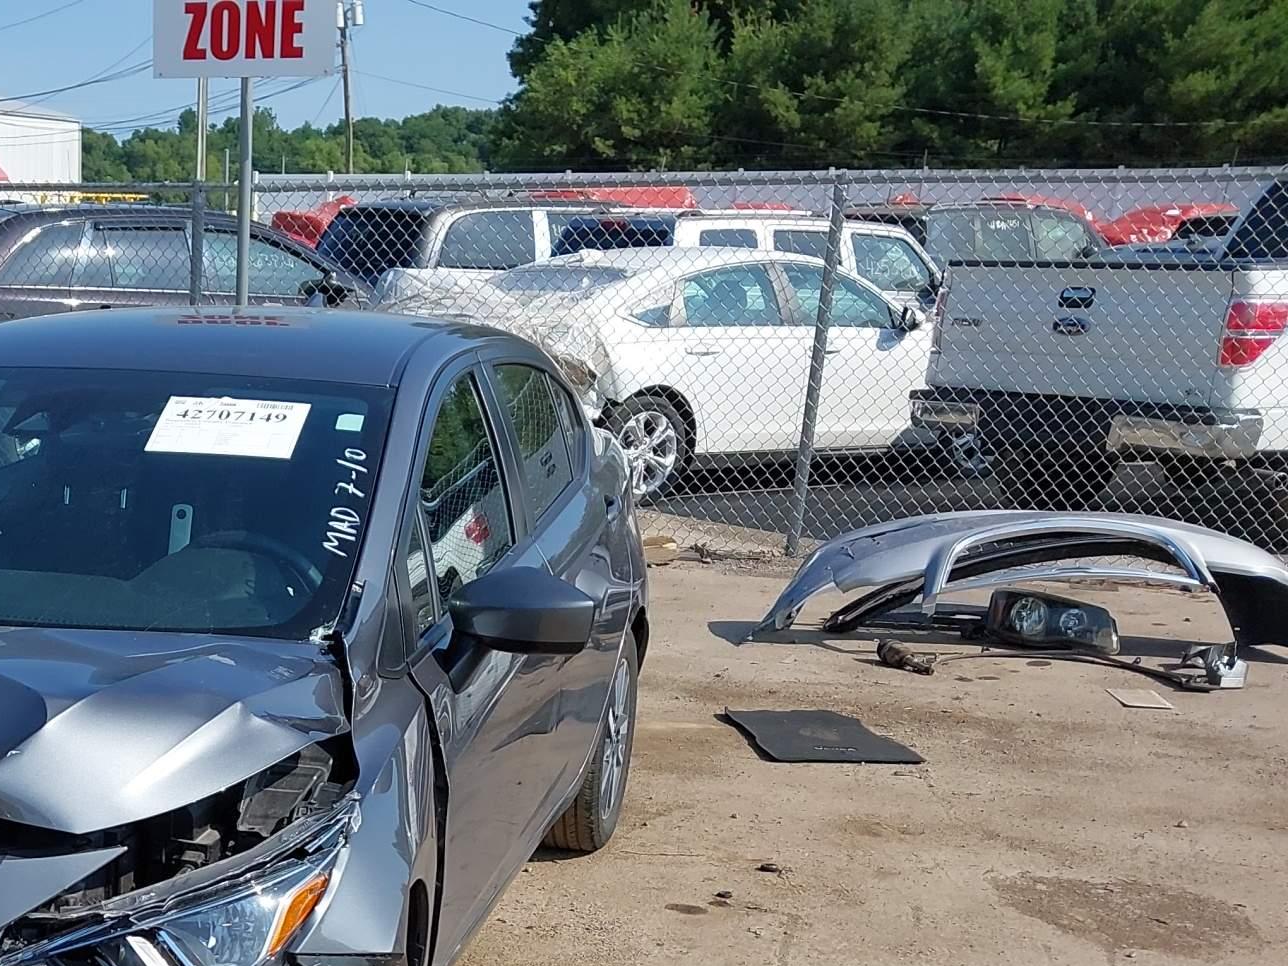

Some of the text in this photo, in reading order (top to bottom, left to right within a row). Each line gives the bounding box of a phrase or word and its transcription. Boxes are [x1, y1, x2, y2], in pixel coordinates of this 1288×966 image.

[183, 0, 305, 61] ZONE
[175, 408, 289, 424] 42707149
[322, 447, 369, 558] MAD 7-10
